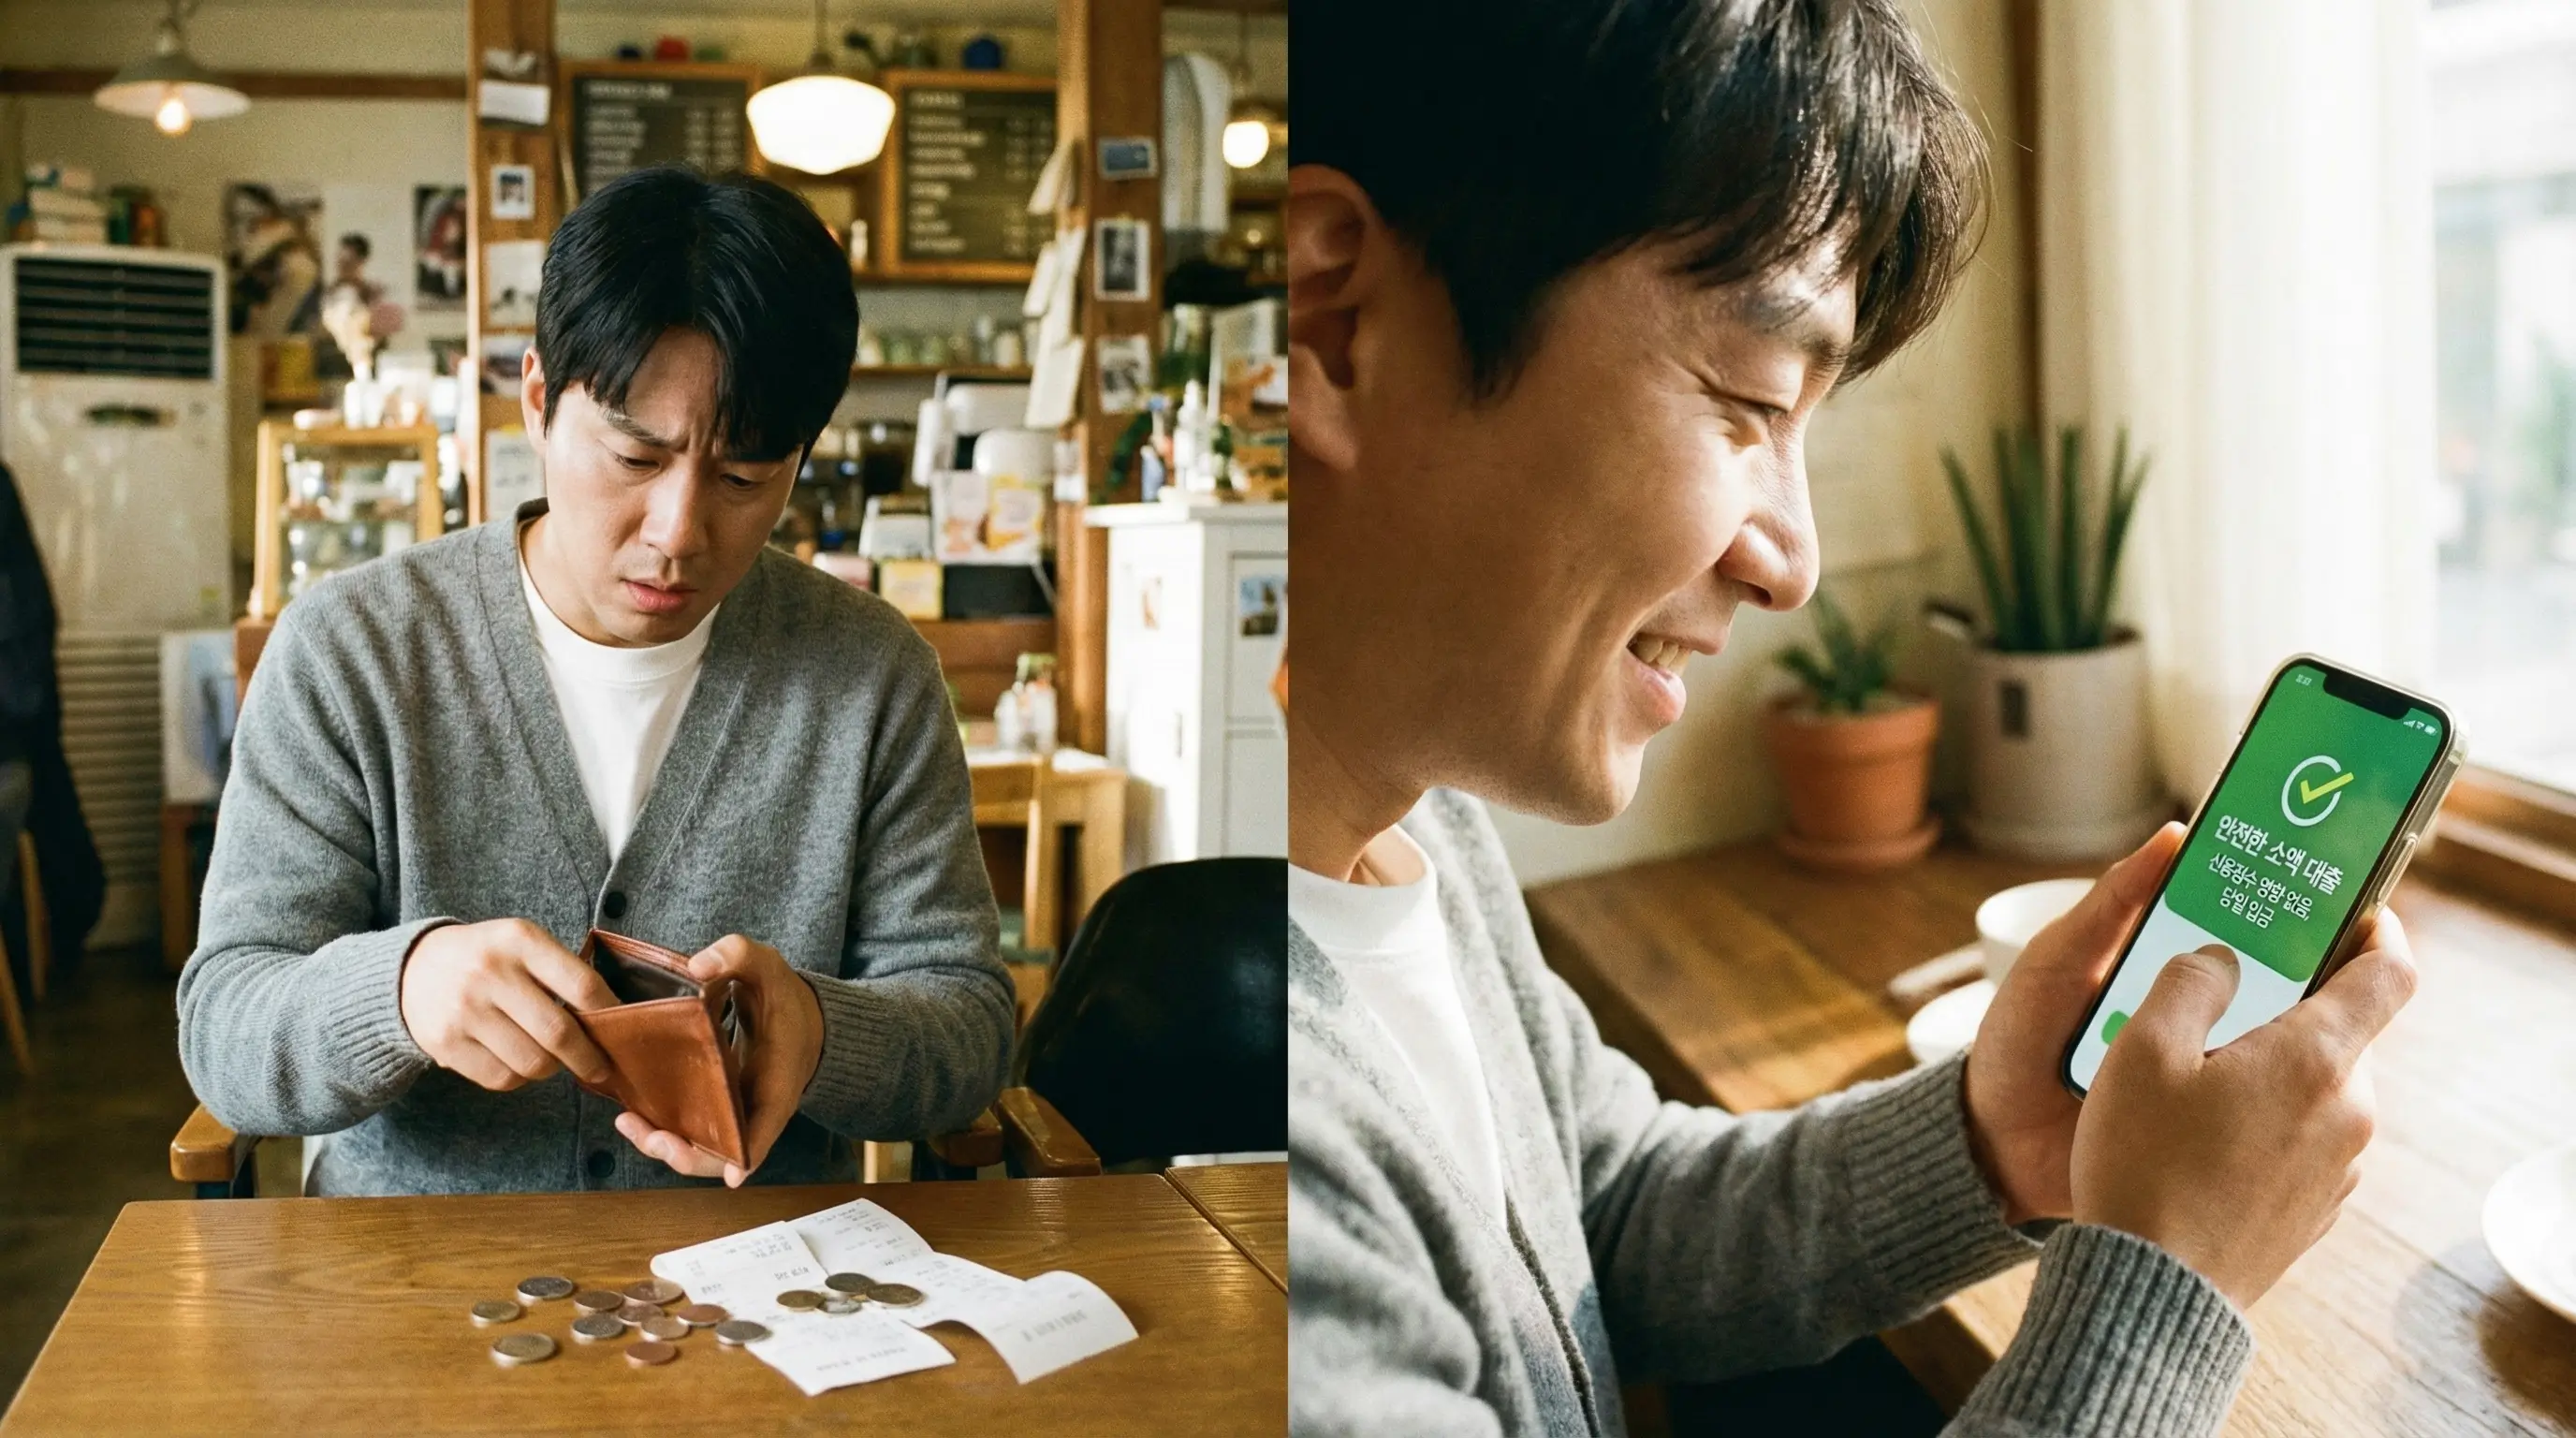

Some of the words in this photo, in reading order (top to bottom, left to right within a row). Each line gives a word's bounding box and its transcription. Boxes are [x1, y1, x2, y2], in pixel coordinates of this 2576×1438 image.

[2215, 814, 2269, 857] 안전한
[2263, 841, 2307, 876] 소액
[2303, 858, 2344, 895] 대출
[2219, 887, 2249, 916] 당일
[2246, 901, 2275, 929] 입금
